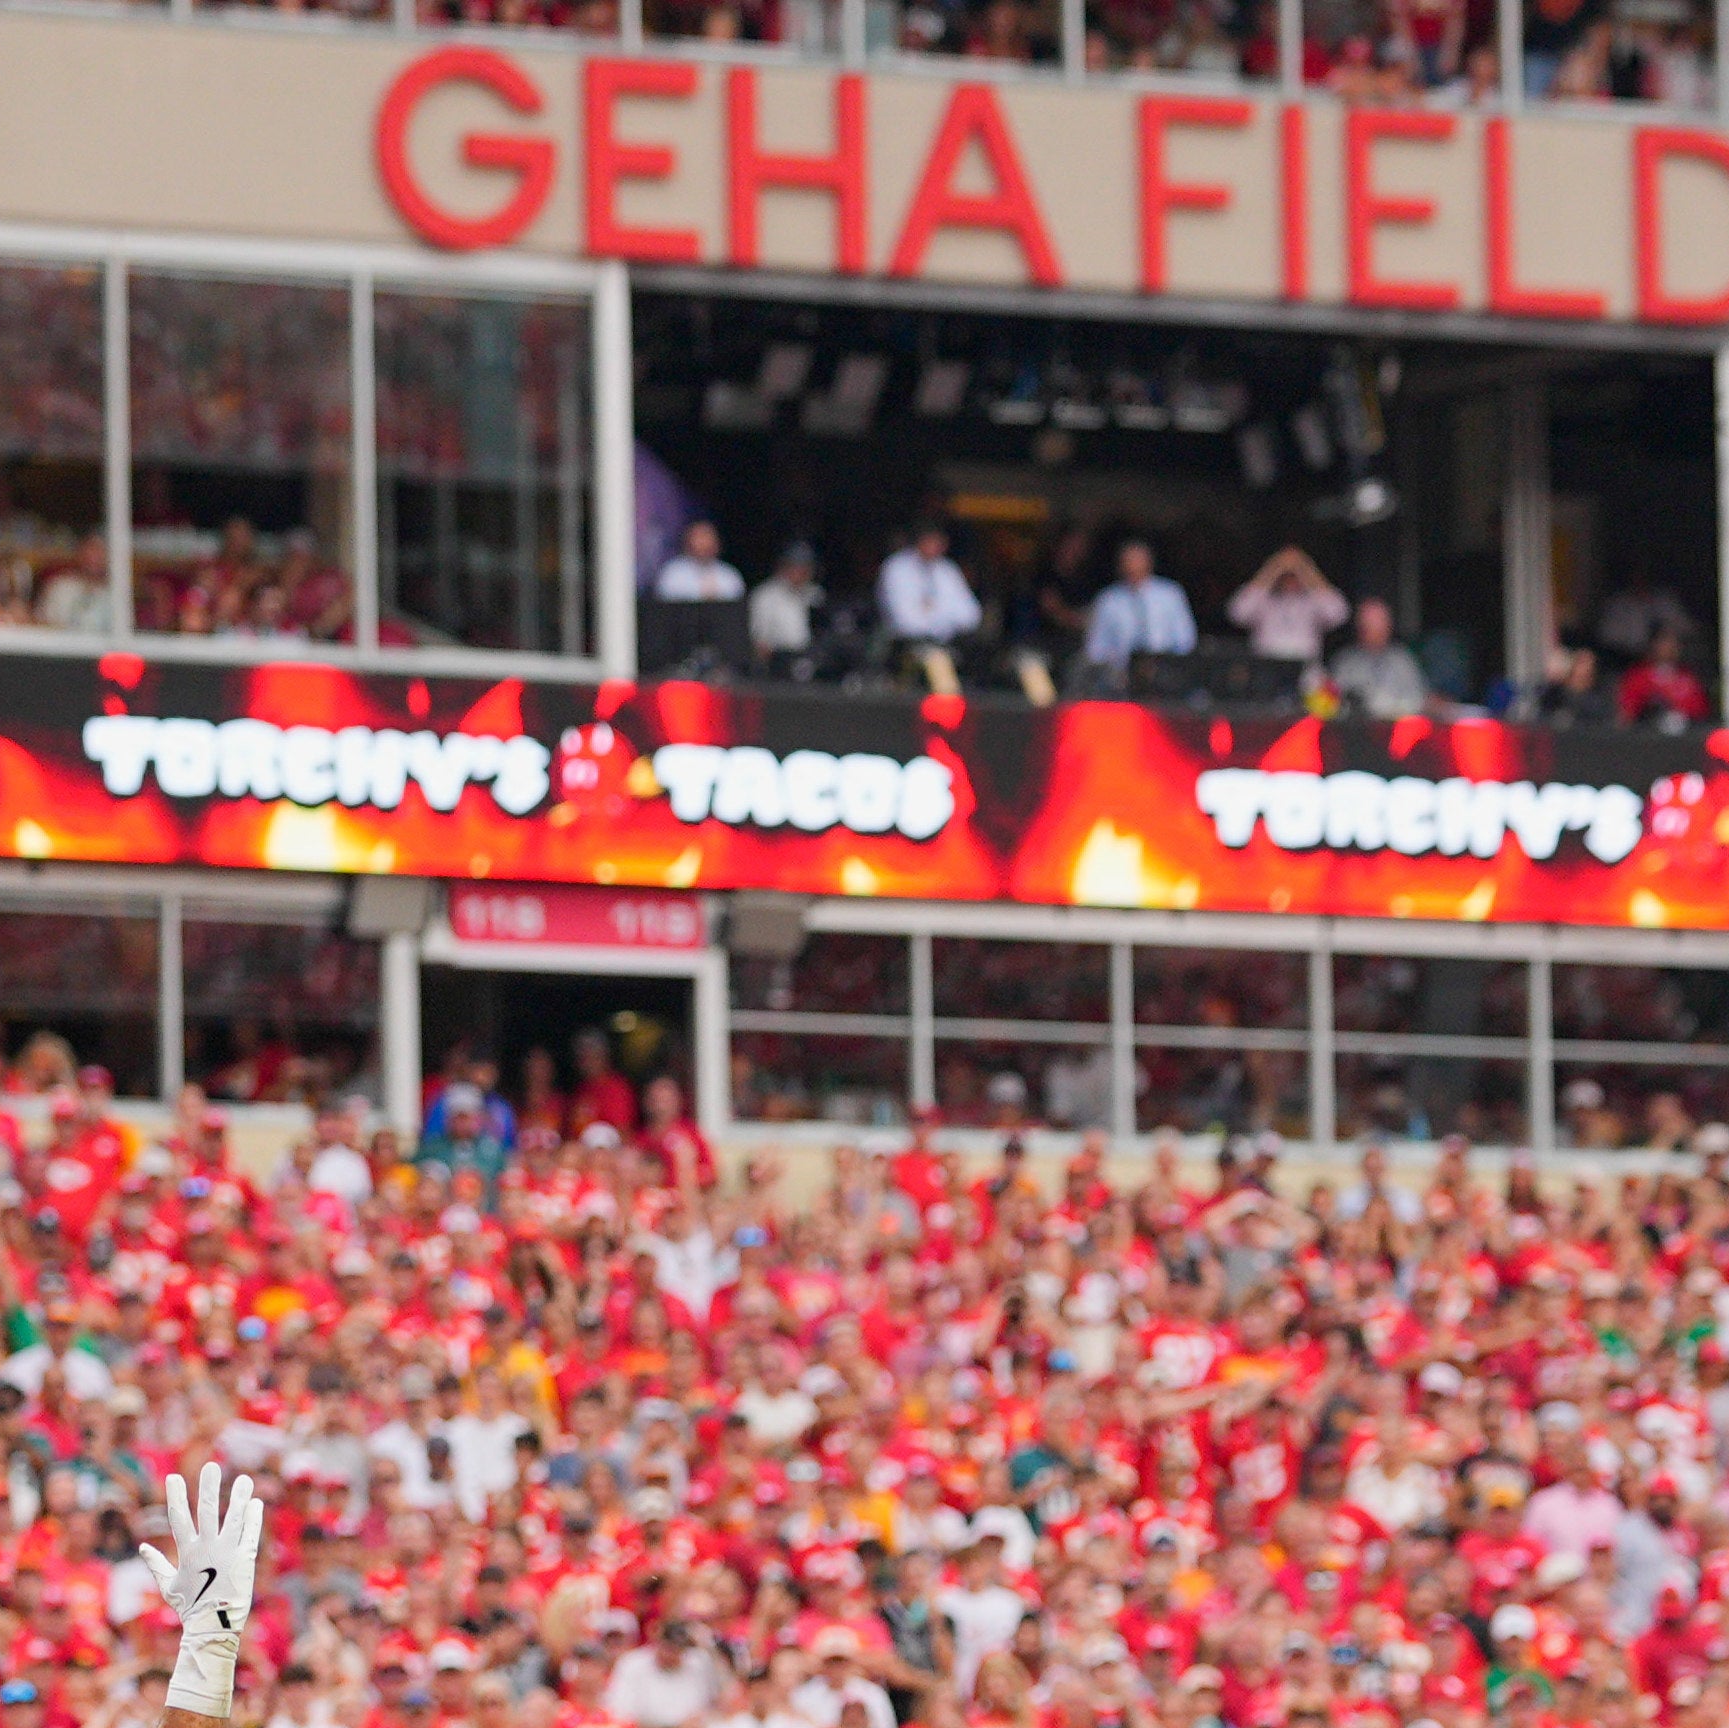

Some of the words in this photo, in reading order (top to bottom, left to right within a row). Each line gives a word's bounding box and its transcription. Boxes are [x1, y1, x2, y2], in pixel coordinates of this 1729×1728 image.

[374, 42, 1065, 289] GEHA
[80, 713, 552, 818] TORCHY'S
[652, 740, 959, 843] TACOS
[1194, 766, 1646, 866] TORCHY'S
